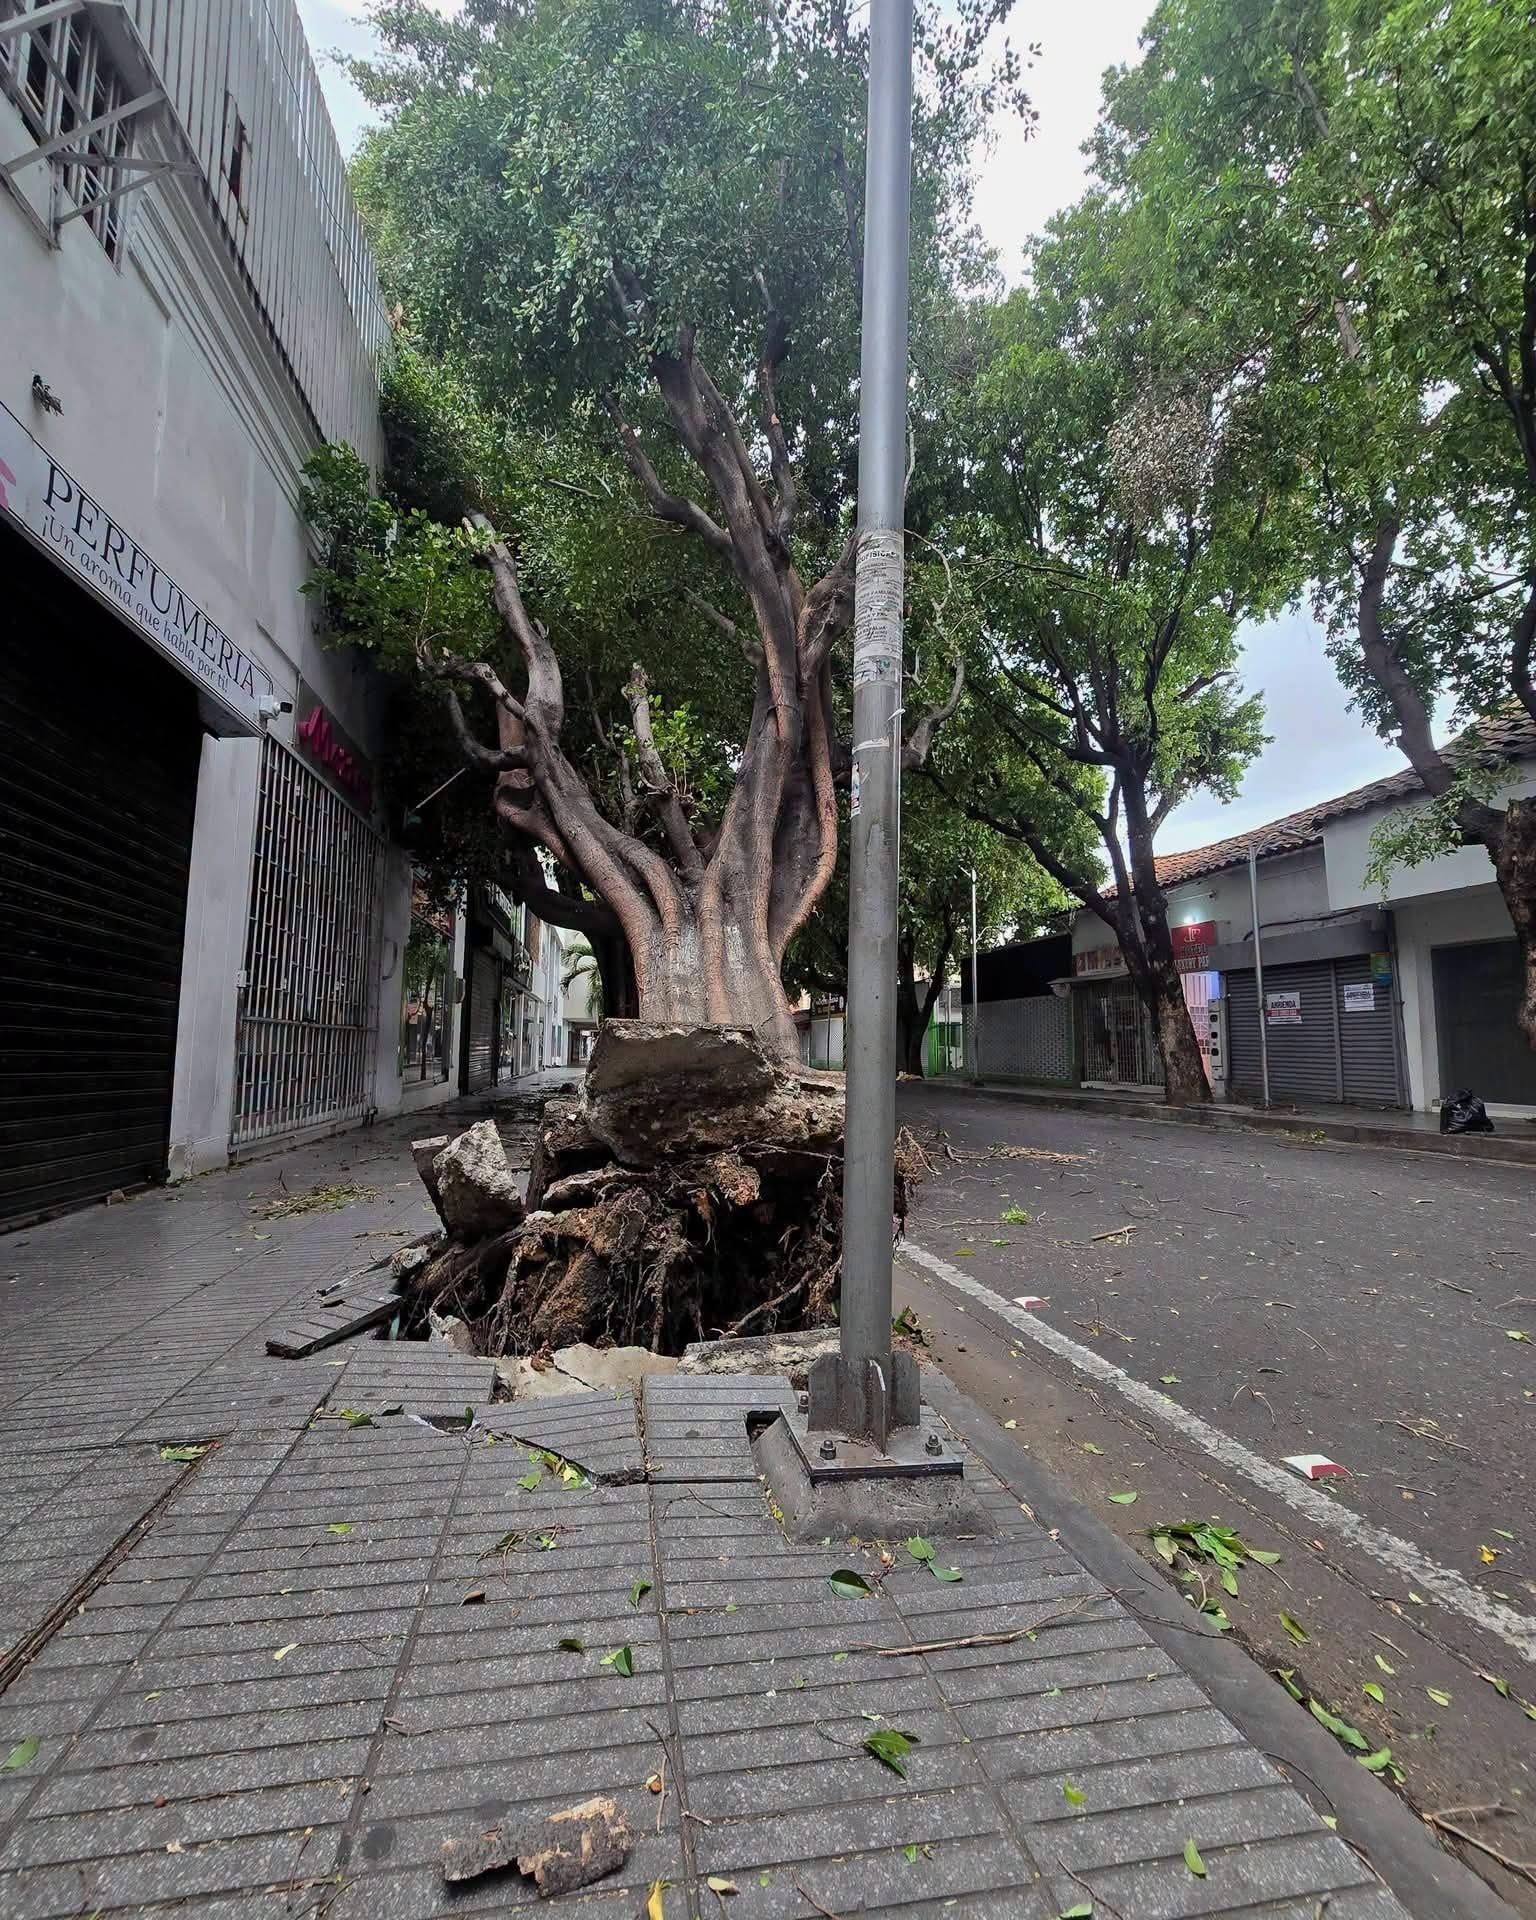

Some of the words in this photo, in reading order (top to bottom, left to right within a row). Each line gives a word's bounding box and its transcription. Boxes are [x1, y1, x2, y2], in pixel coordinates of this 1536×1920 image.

[42, 516, 76, 556] ¡Un
[81, 553, 132, 608] aroma
[136, 603, 160, 634] que
[163, 622, 195, 661] habla
[198, 655, 216, 680] por
[218, 674, 229, 693] ti!
[43, 460, 255, 698] PERFUMERIA
[1181, 944, 1208, 957] HOTEL
[1271, 1000, 1296, 1009] ARRIENDA
